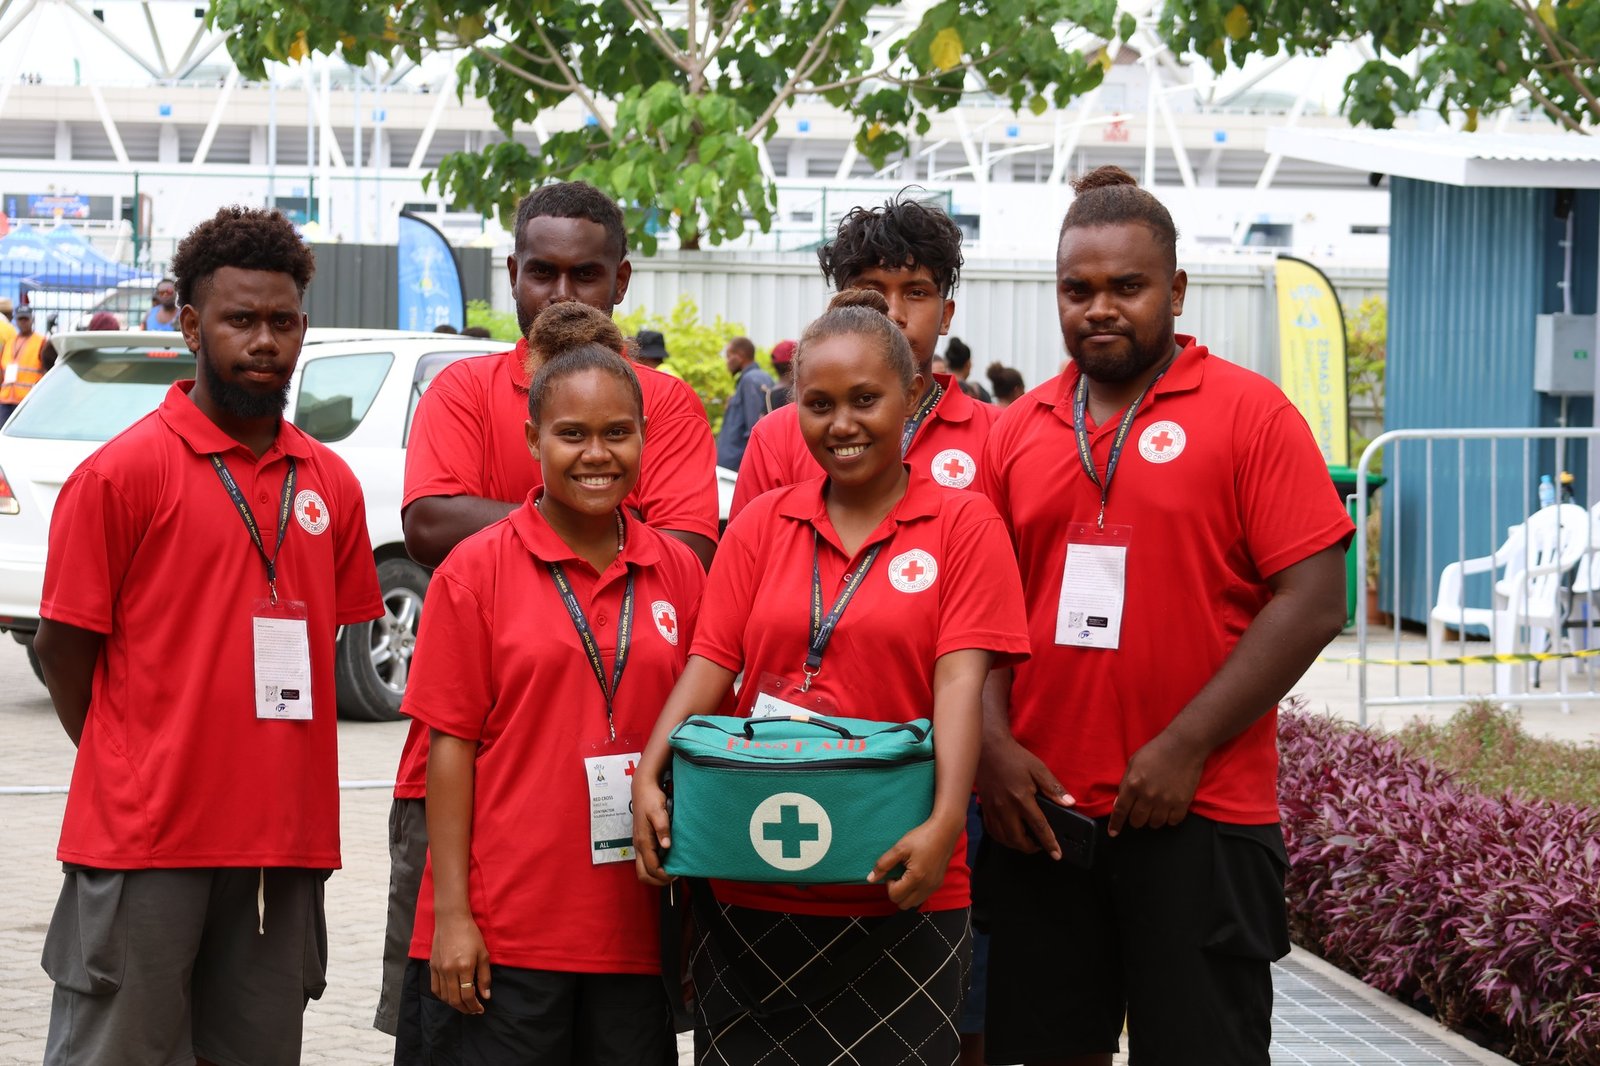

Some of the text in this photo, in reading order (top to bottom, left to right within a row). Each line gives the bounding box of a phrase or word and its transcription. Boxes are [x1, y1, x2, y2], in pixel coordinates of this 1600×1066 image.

[239, 503, 254, 526] SOL2023
[582, 632, 595, 656] SOL2023
[619, 636, 627, 660] SOL2023
